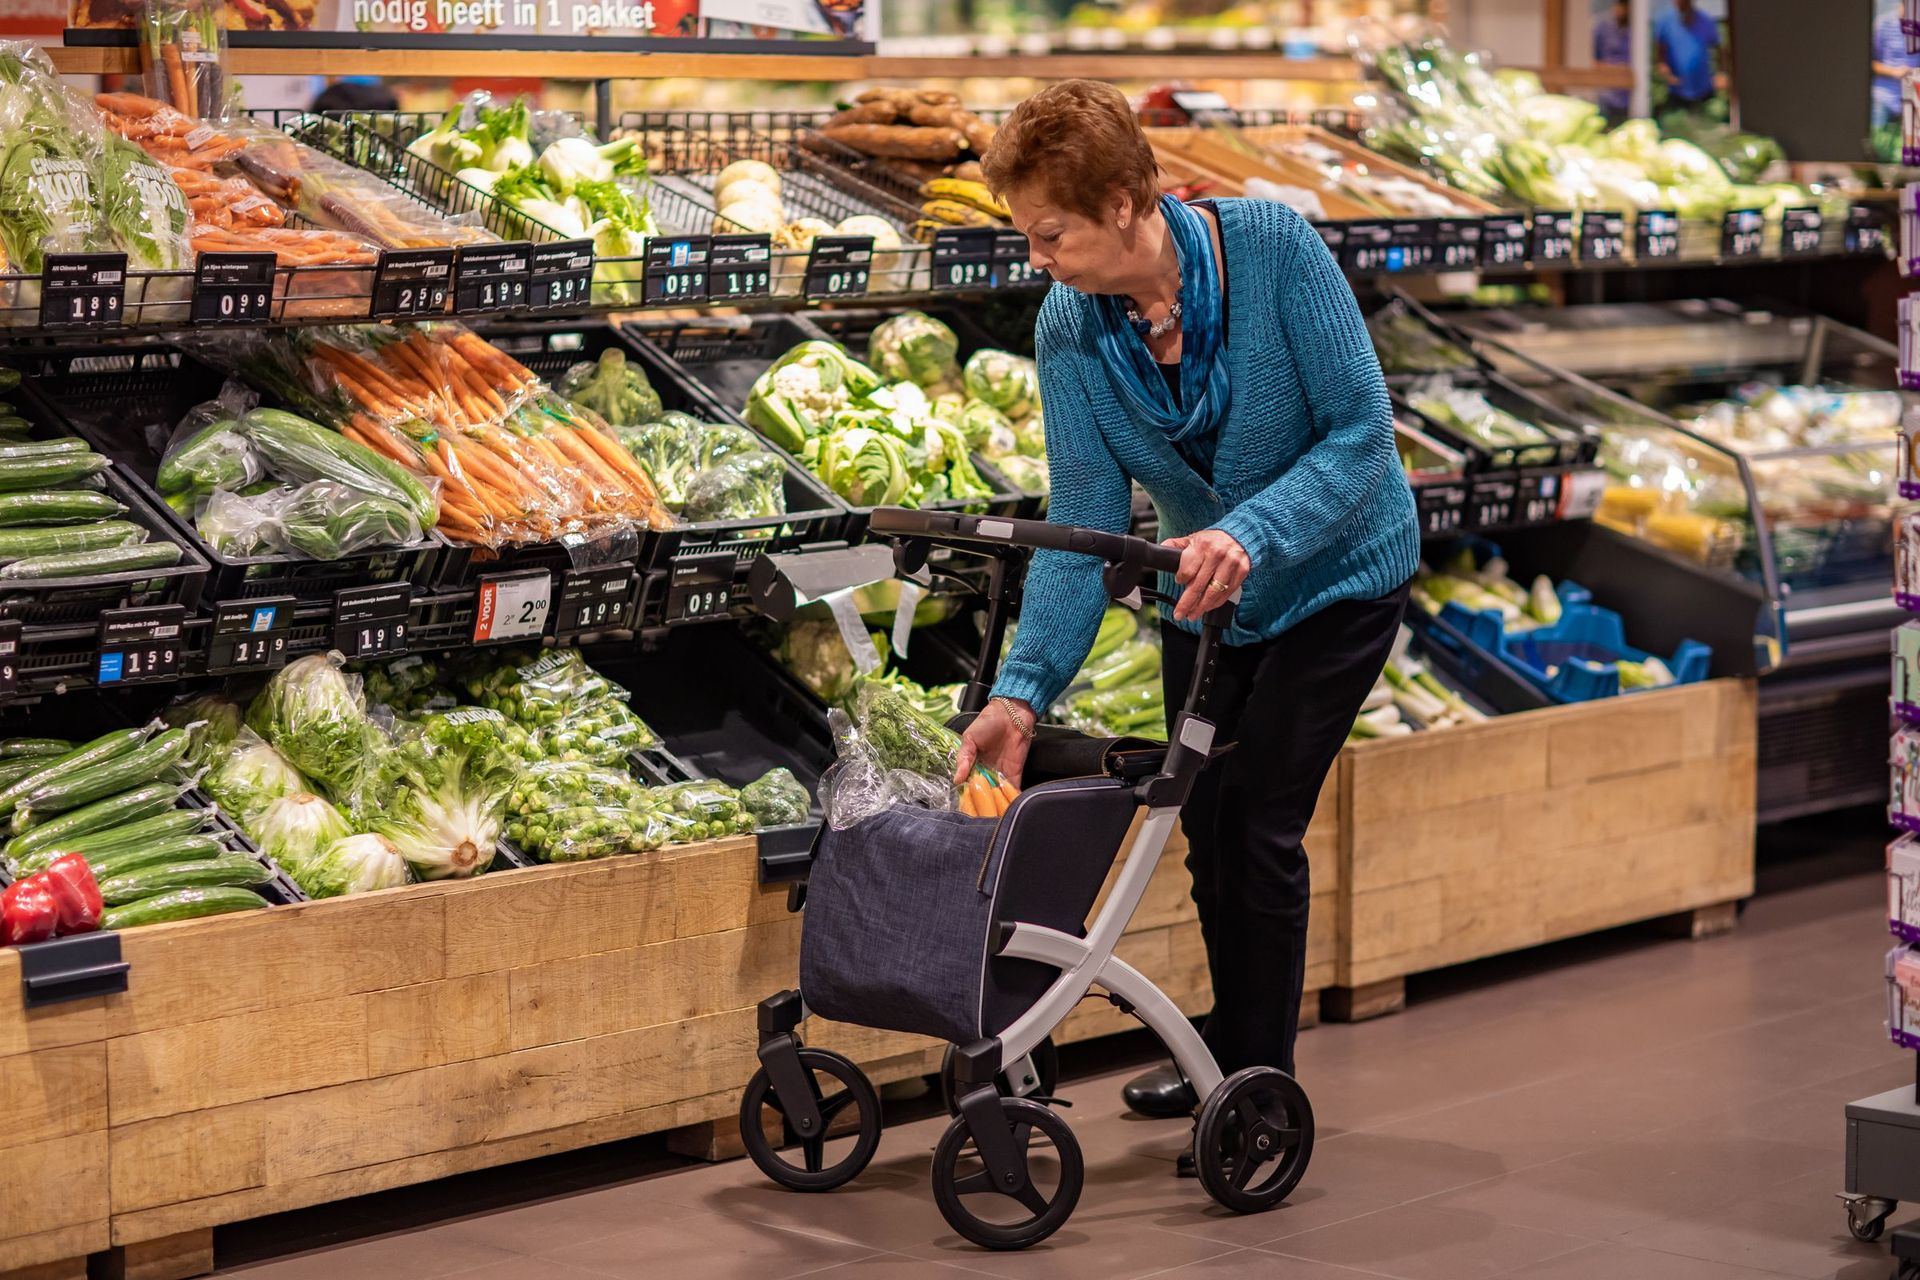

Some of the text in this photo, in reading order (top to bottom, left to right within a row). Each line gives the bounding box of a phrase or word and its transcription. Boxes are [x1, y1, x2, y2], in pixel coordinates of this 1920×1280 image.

[354, 0, 656, 32] nodig heeft in 1 pakket
[35, 171, 95, 206] KOOL
[481, 588, 493, 622] VOOR
